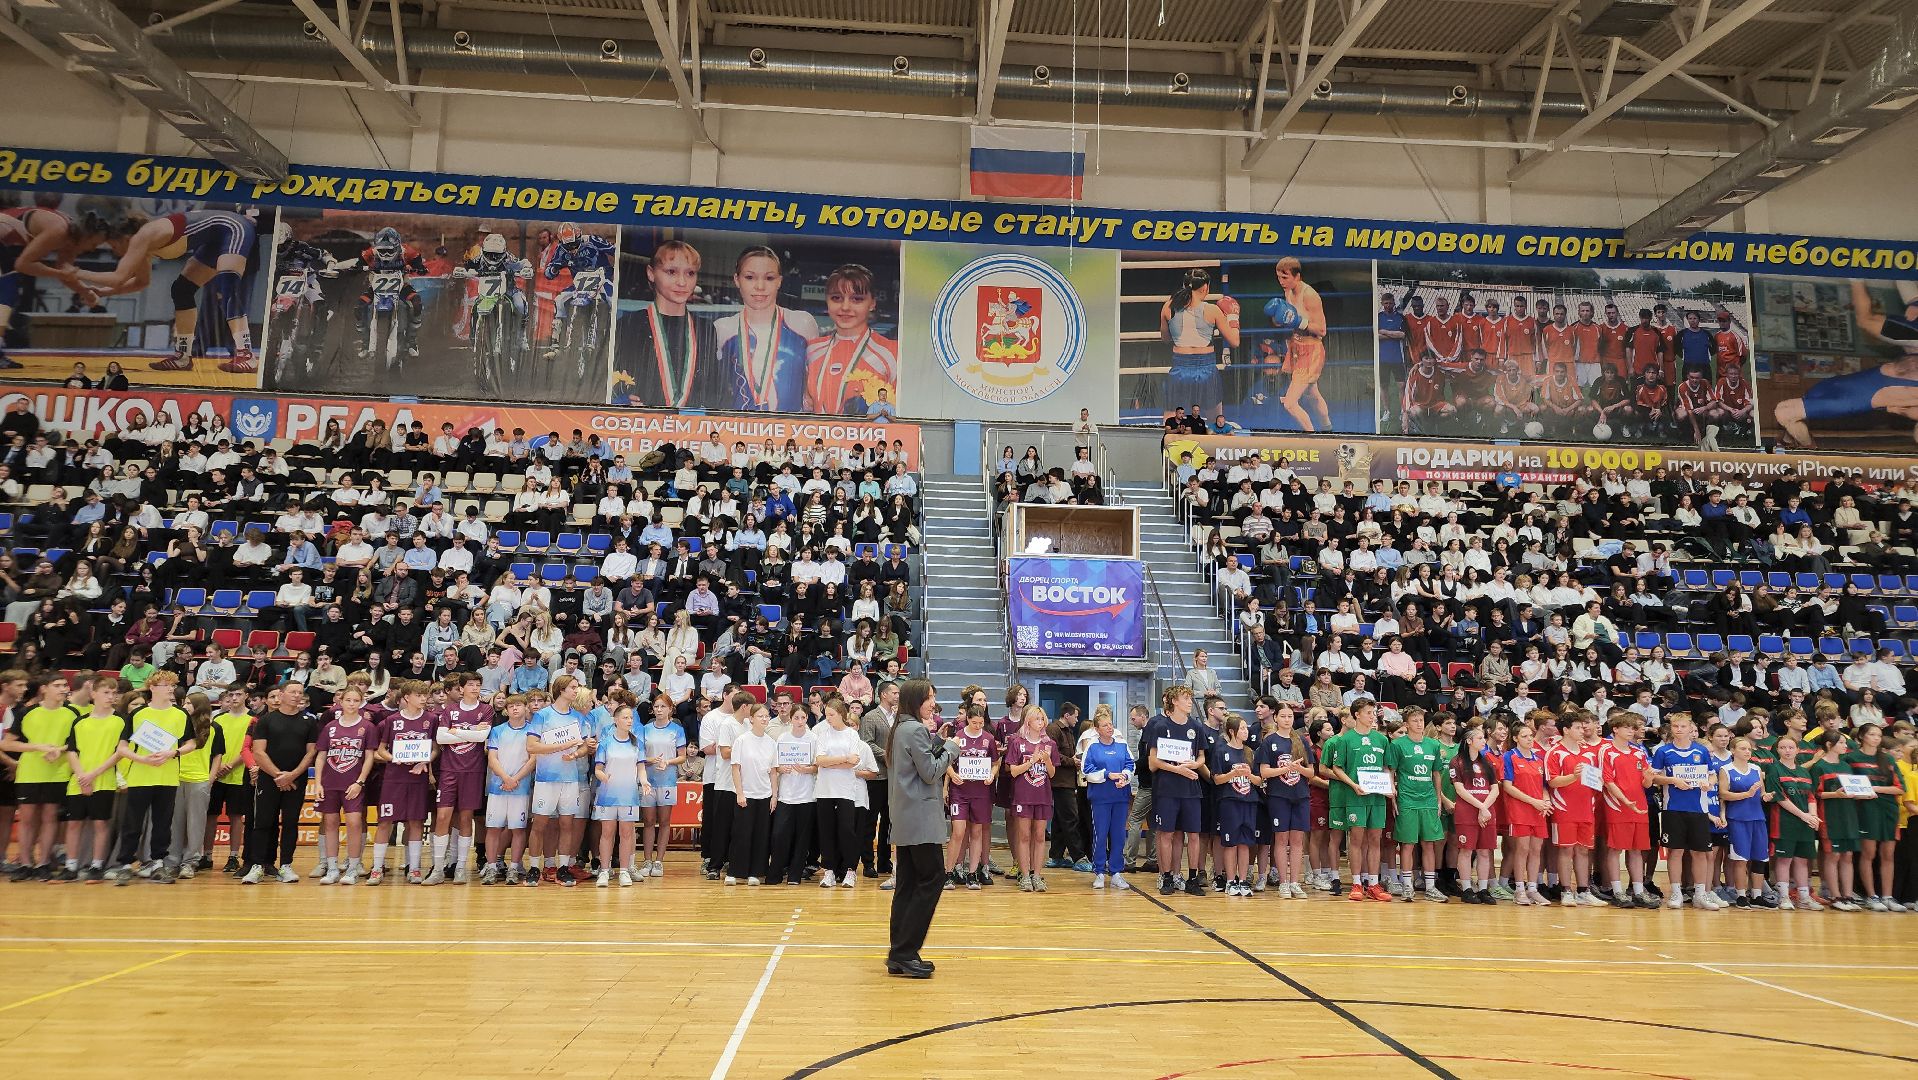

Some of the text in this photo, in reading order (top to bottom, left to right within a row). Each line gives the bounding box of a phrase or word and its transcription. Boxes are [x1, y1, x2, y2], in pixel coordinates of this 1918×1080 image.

[126, 158, 240, 196] будут
[491, 185, 619, 213] новые
[632, 194, 807, 229] таланты,
[818, 204, 983, 235] которые
[994, 212, 1122, 244] станут
[1132, 219, 1279, 245] светить
[1290, 225, 1334, 247] на
[1345, 227, 1506, 256] мировом
[1746, 239, 1918, 271] небоскло
[484, 280, 500, 296] 7
[955, 374, 1062, 403] МОСКОВСКОЙ ОБЛАСТИ
[979, 383, 1035, 396] МИНСПОРТ
[591, 415, 886, 442] СОЗДАЁМ ЛУЧШИЕ УСЛОВИЯ
[1396, 447, 1514, 469] ПОДАРКИ
[1518, 455, 1543, 468] на
[1546, 448, 1579, 469] 10
[1584, 450, 1639, 471] 000
[1710, 460, 1792, 478] покупке
[1797, 460, 1863, 477] iPhone
[1869, 467, 1905, 481] или
[1019, 576, 1079, 585] ДВОРЕЦ СПОРТА
[1032, 586, 1127, 604] ВОСТОК
[450, 711, 460, 720] 12
[393, 720, 405, 731] 13
[329, 727, 336, 738] 2
[664, 790, 670, 800] 2
[380, 803, 394, 817] 13
[520, 811, 526, 822] 3
